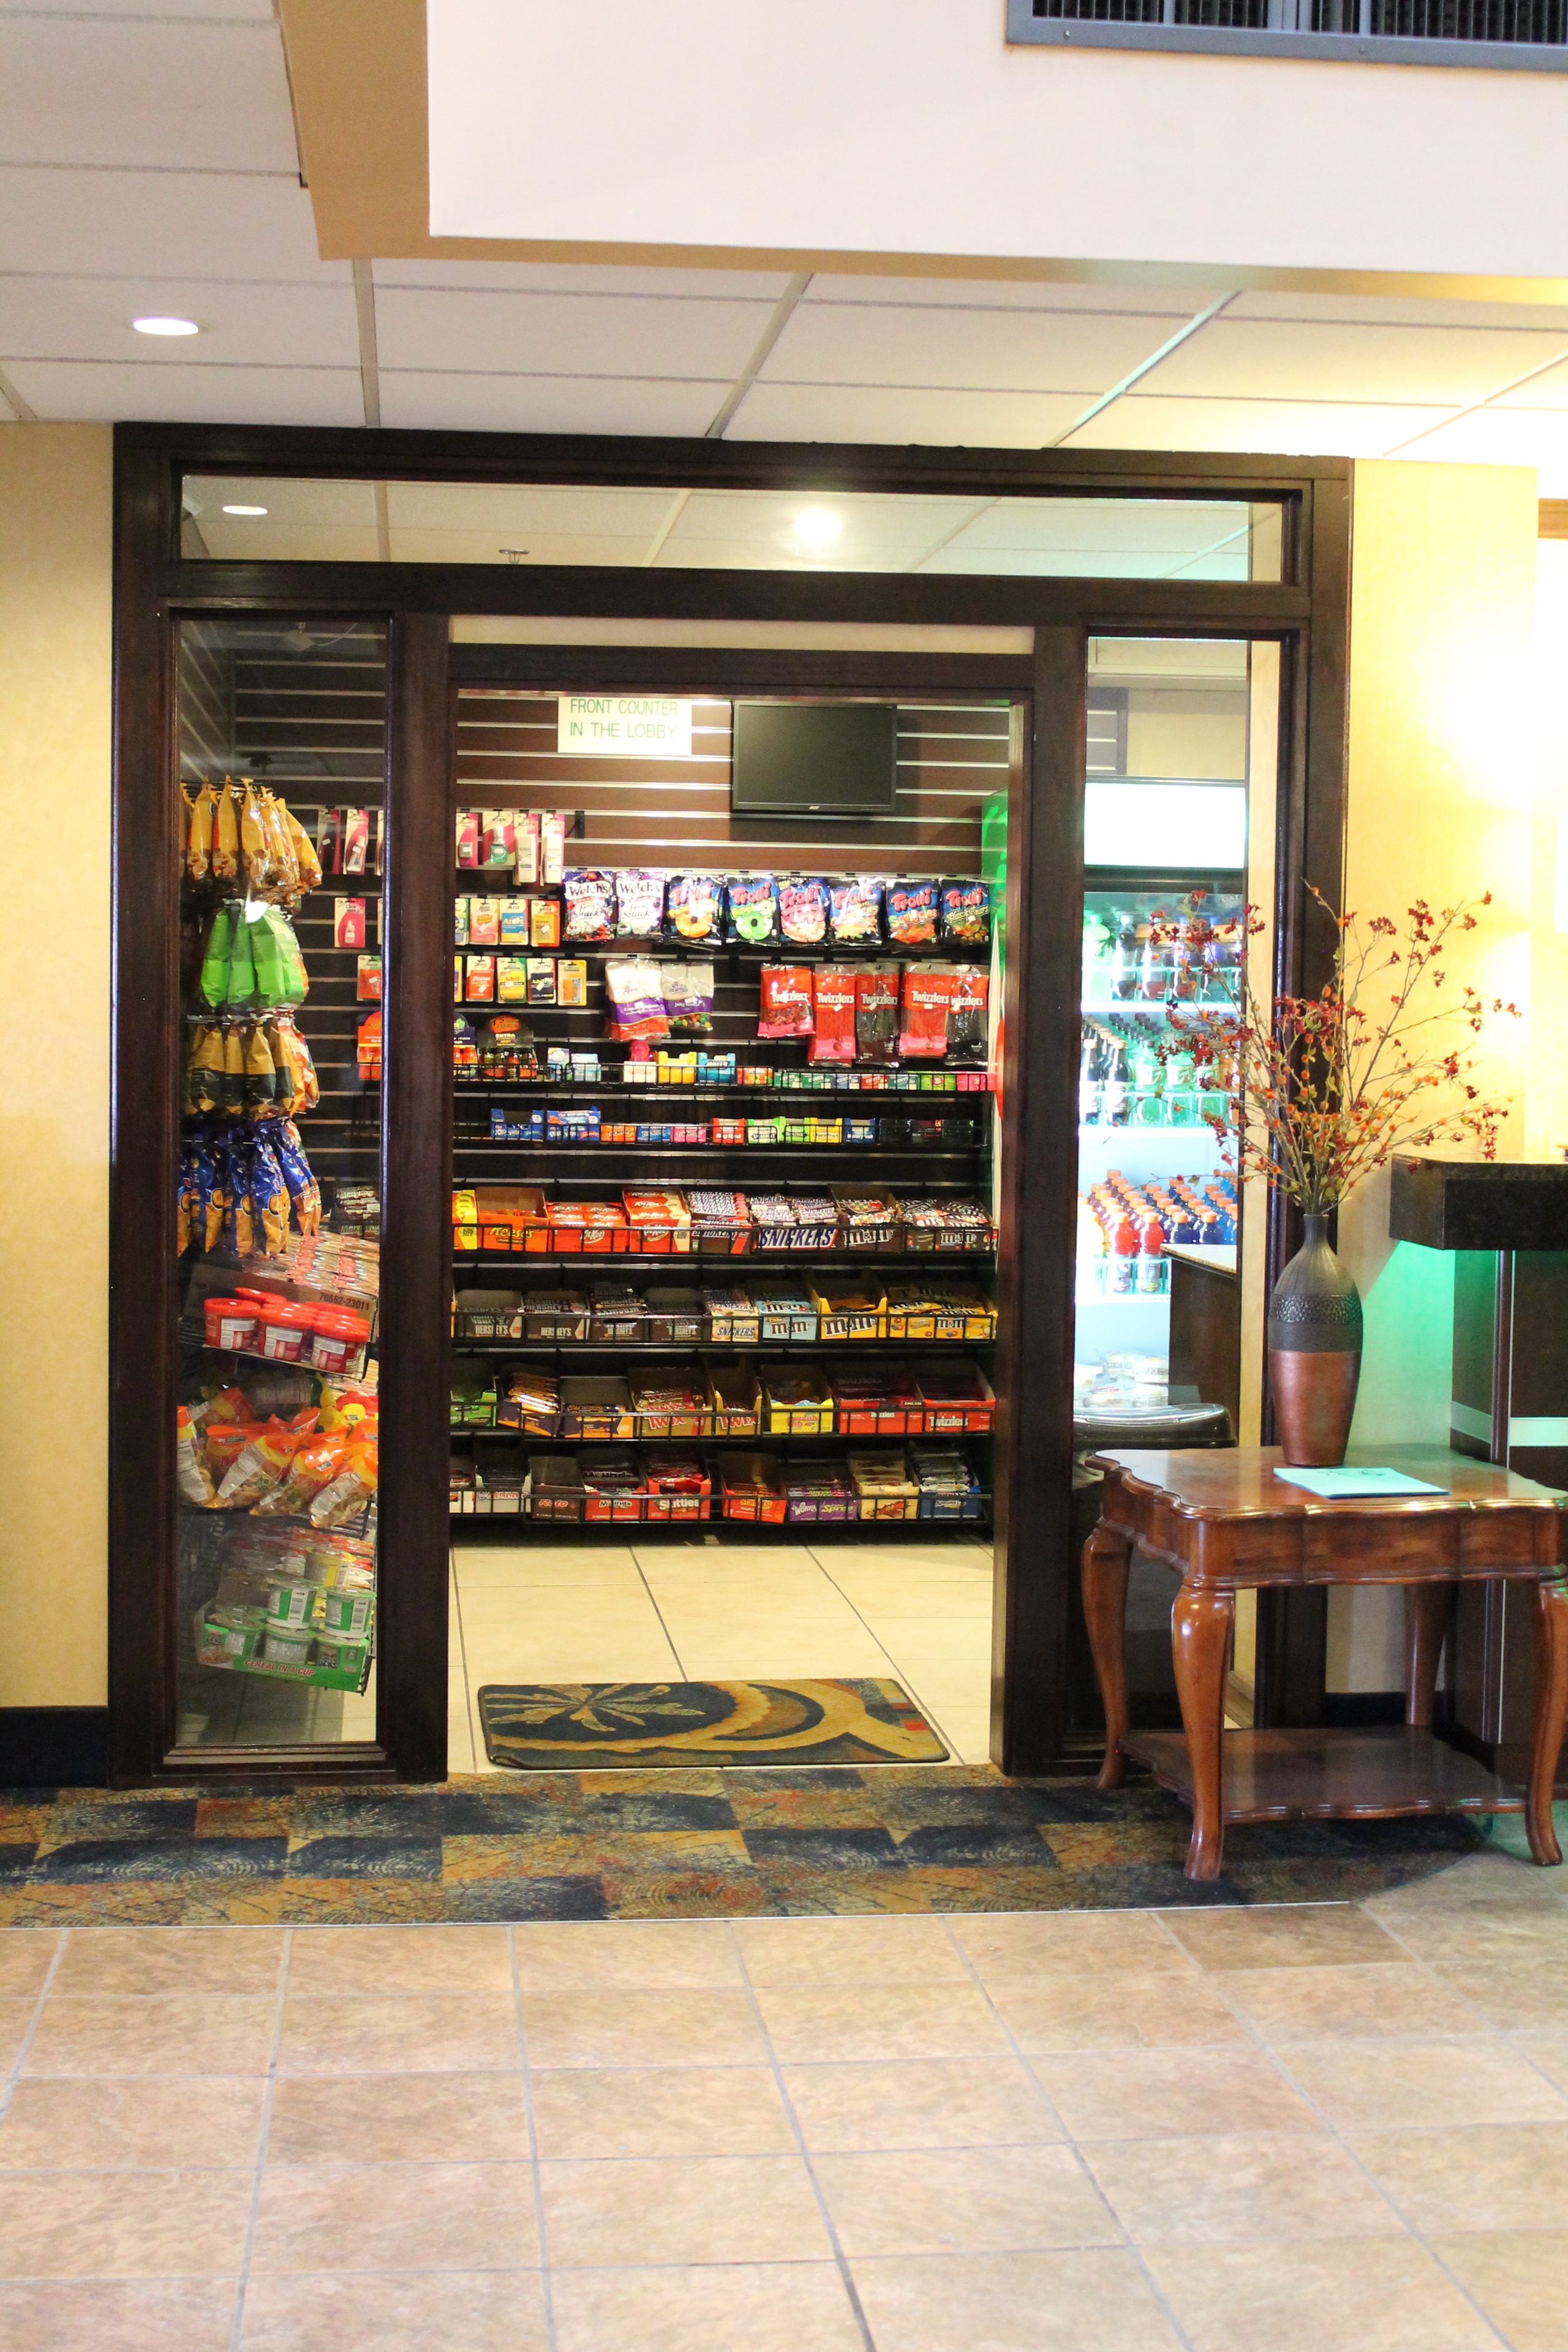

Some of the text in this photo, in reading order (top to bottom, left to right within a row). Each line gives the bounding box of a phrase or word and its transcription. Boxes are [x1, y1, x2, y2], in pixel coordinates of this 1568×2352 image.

[570, 698, 677, 715] FRONT COUNTER
[570, 722, 677, 739] IN THE LOBBY
[569, 883, 608, 896] Welh's
[730, 881, 771, 905] Trolli
[779, 883, 821, 908] Trolli
[946, 886, 983, 909] Trolli
[890, 888, 932, 911] Trolli
[816, 992, 855, 1004] Twizzlers
[911, 990, 949, 1004] Twizzlers
[951, 995, 983, 1006] wizzlers
[761, 1228, 834, 1246] SNICKERS
[607, 1326, 633, 1335] HESHEY'S
[717, 1327, 755, 1336] SNICKERS
[929, 1415, 968, 1427] Twizzlers
[245, 1659, 275, 1670] CEREAL
[279, 1664, 287, 1673] IN
[297, 1667, 315, 1676] CUP
